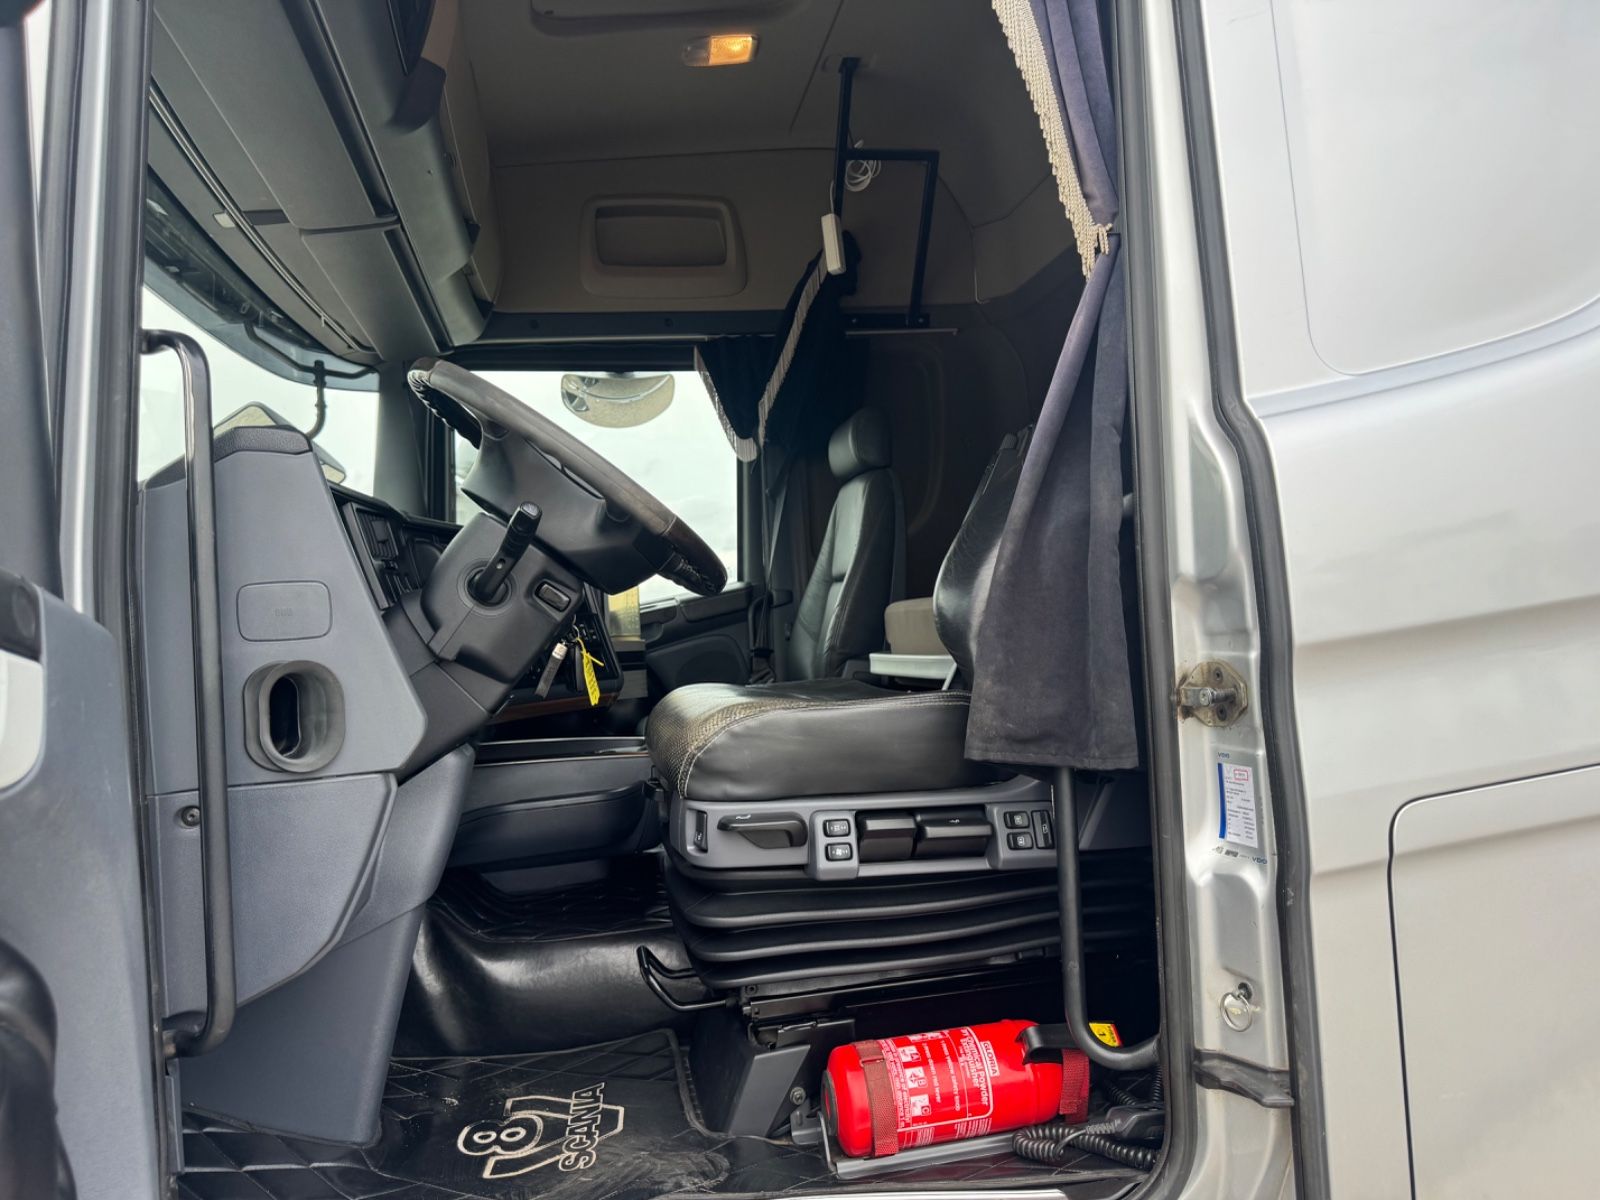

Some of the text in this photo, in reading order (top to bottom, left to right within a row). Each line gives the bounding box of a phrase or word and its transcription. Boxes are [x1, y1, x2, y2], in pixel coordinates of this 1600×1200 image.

[960, 1038, 979, 1088] Extinguisher
[965, 1036, 983, 1069] Chemical
[978, 1071, 989, 1106] Powder
[983, 1042, 998, 1075] GLORIA
[558, 1082, 605, 1172] SCANIA
